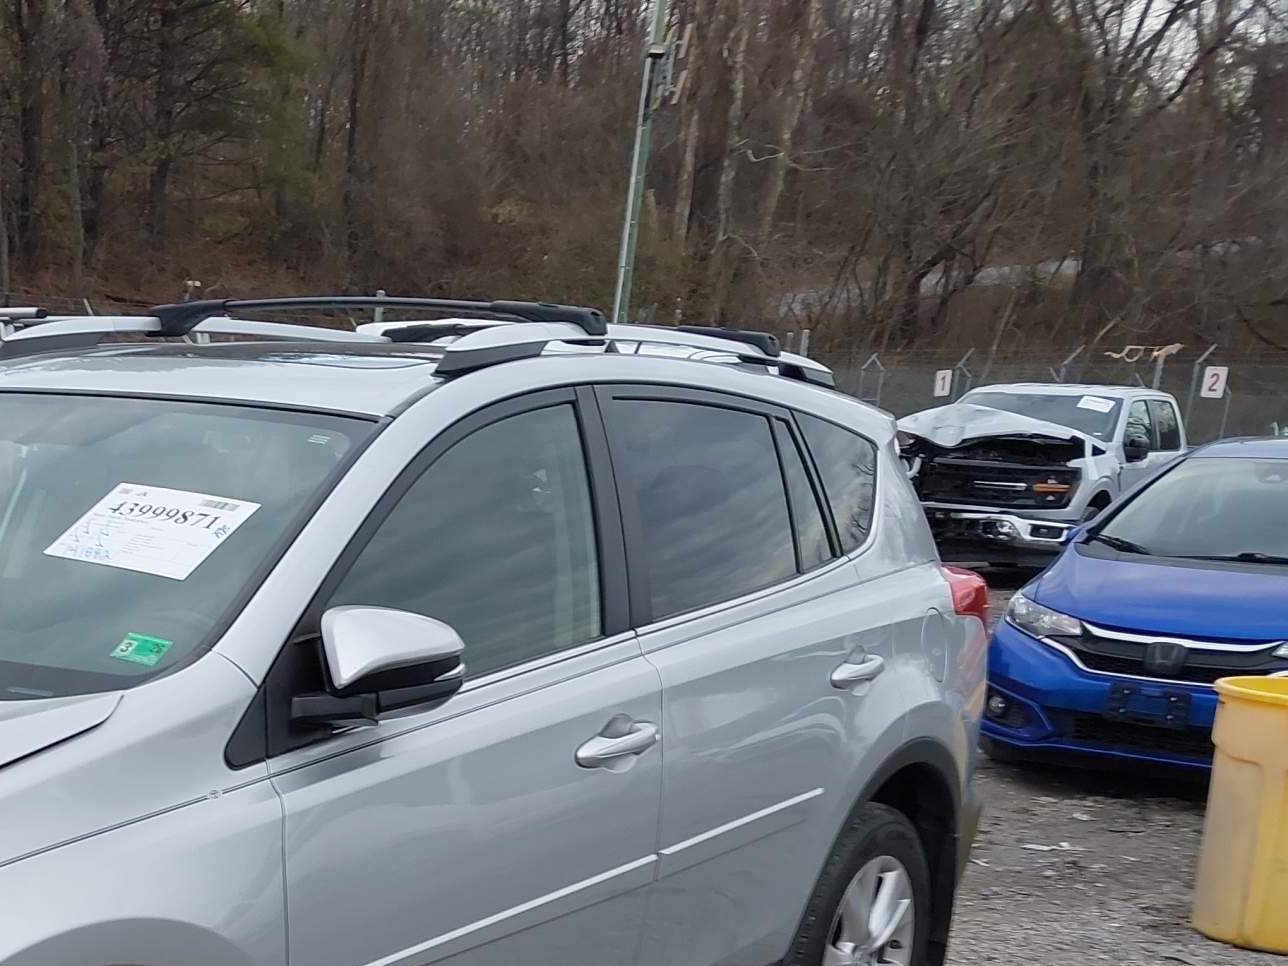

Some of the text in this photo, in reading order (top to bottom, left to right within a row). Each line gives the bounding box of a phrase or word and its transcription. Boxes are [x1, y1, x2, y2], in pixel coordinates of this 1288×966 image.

[939, 371, 949, 393] 1
[1207, 372, 1223, 393] 2
[108, 500, 221, 530] 43999871
[119, 641, 134, 653] 3
